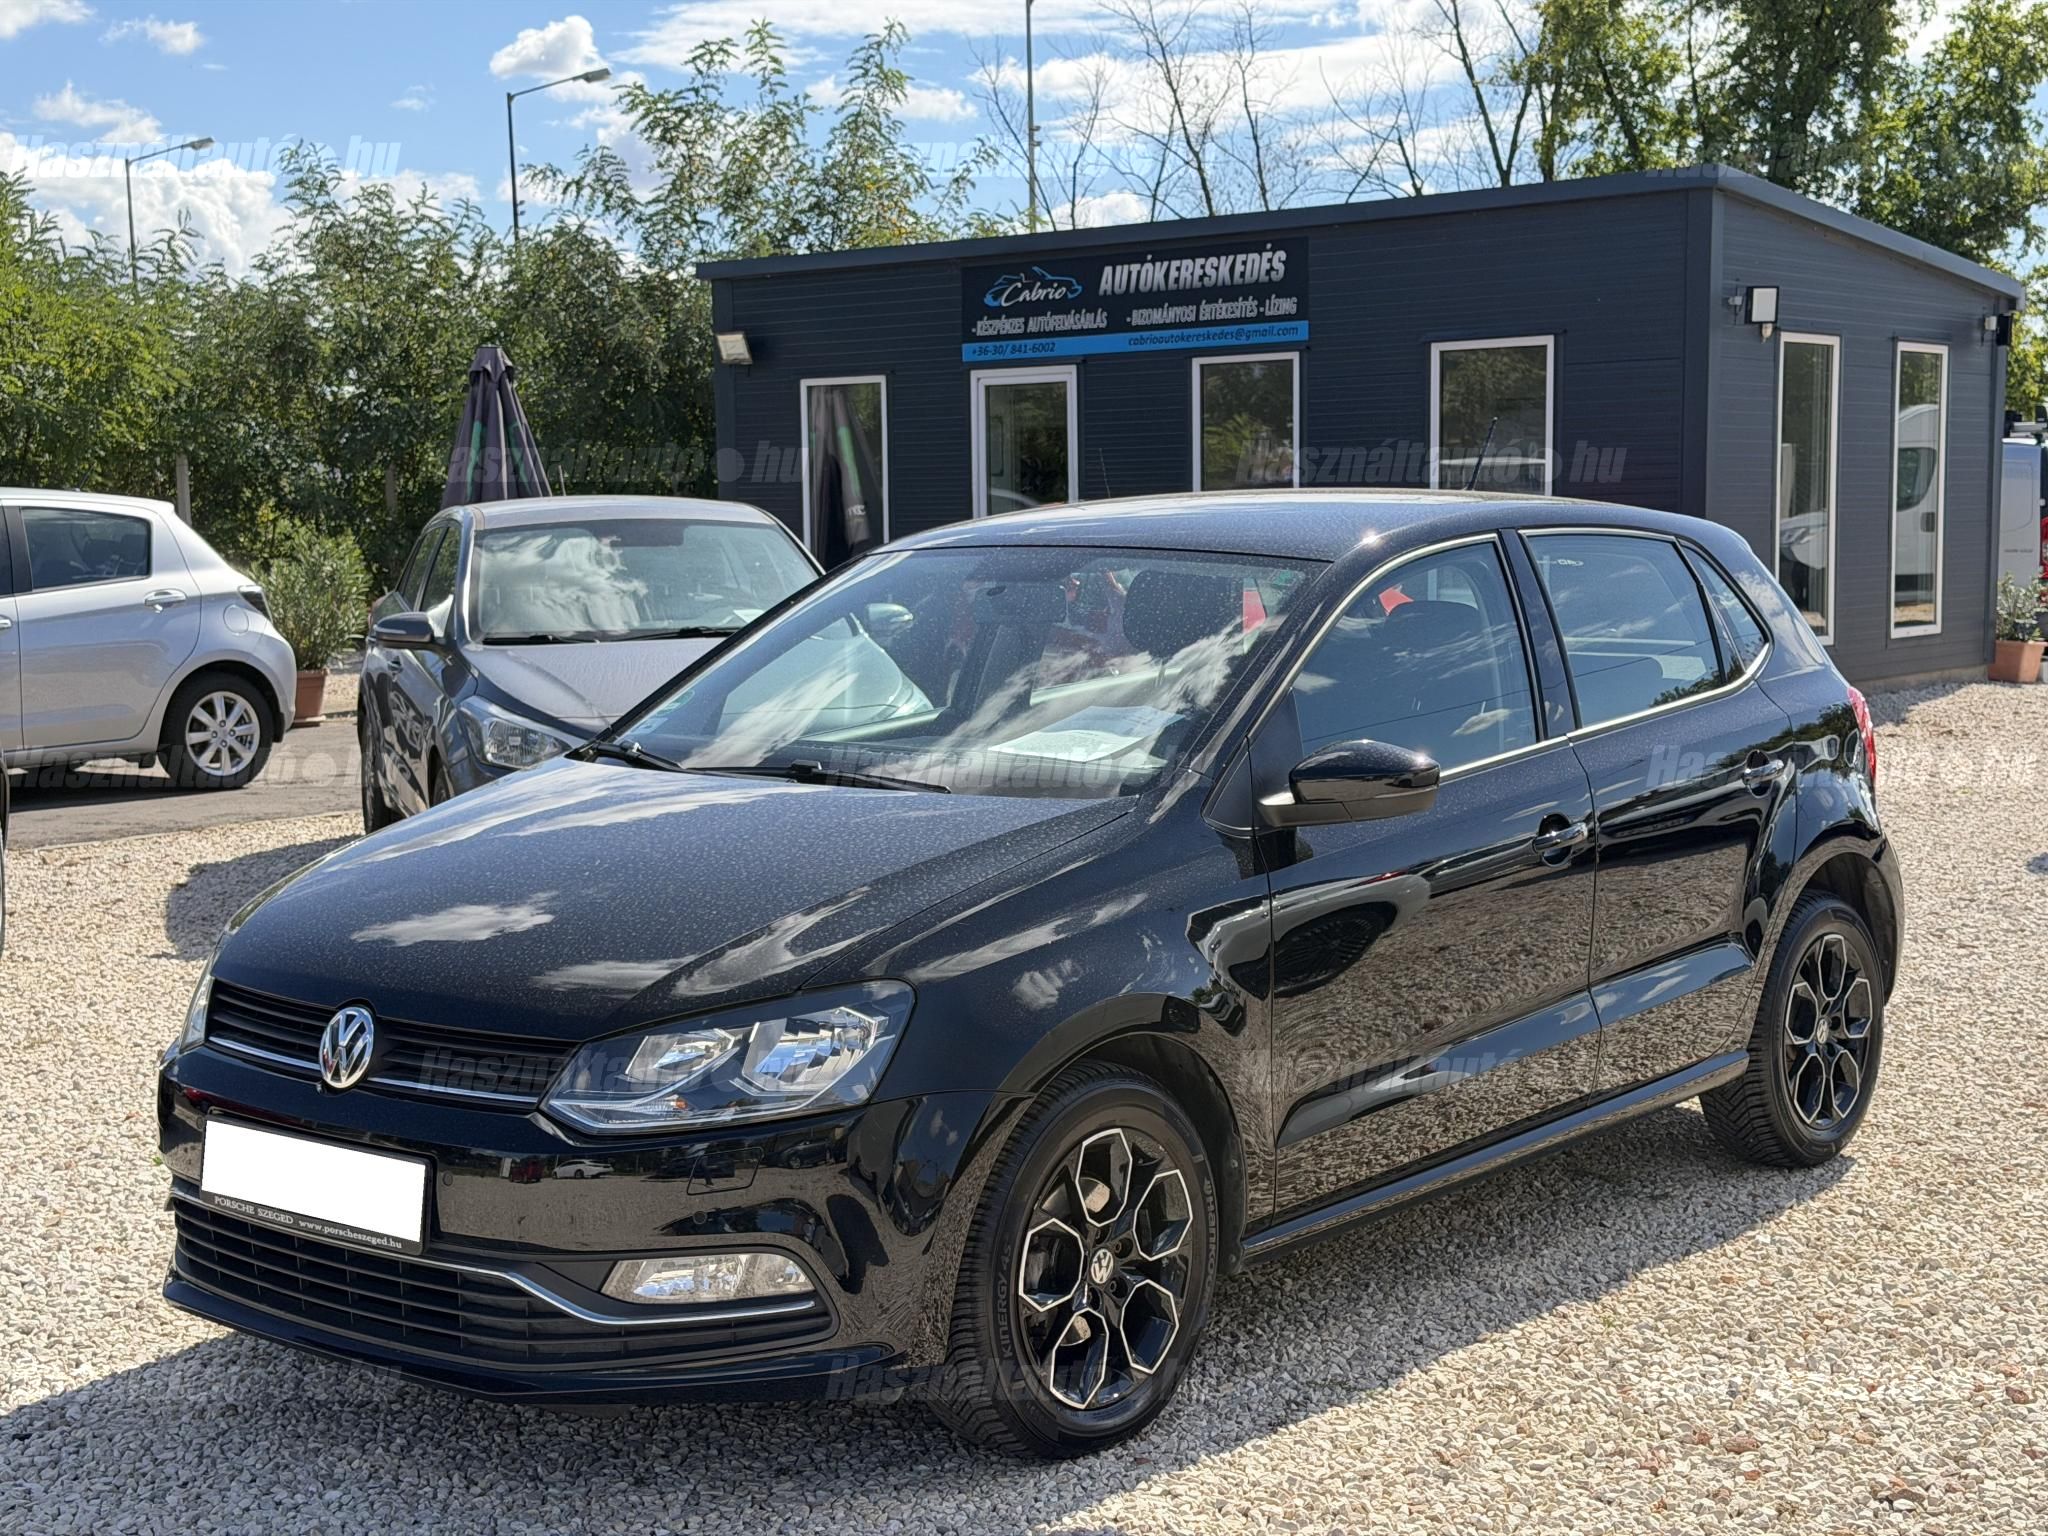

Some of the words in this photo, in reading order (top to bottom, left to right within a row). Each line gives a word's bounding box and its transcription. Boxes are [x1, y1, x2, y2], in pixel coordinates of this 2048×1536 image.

[1099, 243, 1287, 296] AUTÓKERESKEDÉS
[1001, 282, 1067, 307] Cabrio
[1027, 308, 1108, 333] AUTÓFELVÁSÁRLÁS
[1199, 296, 1258, 321] ÉRTÉKESÍTÉS
[1128, 326, 1298, 346] cabrioautokereskedes@gmail.com
[214, 1196, 255, 1215] PORSCHE
[257, 1208, 294, 1225] SZEGED
[299, 1219, 402, 1249] www.porscheszeged.hu
